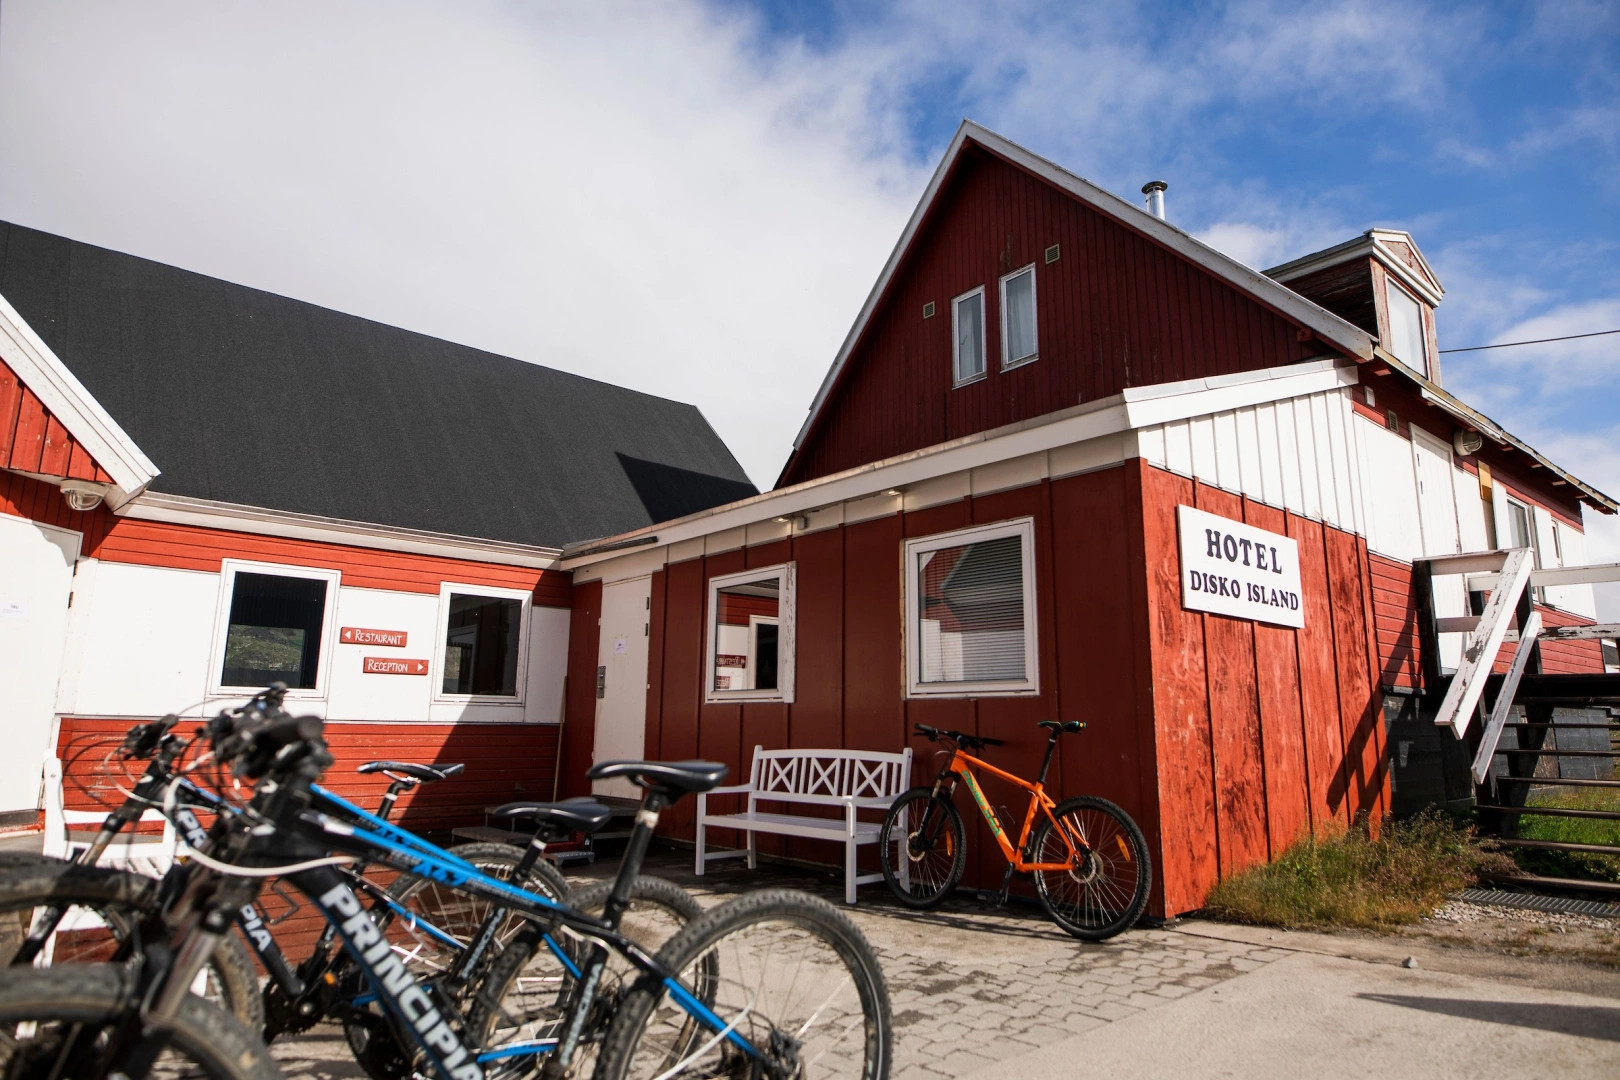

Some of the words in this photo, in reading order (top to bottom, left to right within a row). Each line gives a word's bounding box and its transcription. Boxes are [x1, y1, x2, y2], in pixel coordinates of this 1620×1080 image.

[1205, 528, 1282, 574] HOTEL
[1190, 570, 1241, 599] DISKO
[1246, 582, 1299, 611] ISLAND
[354, 629, 402, 646] RESTAURANT
[367, 658, 408, 673] RECEPTION
[319, 882, 484, 1080] PRINCIPIA
